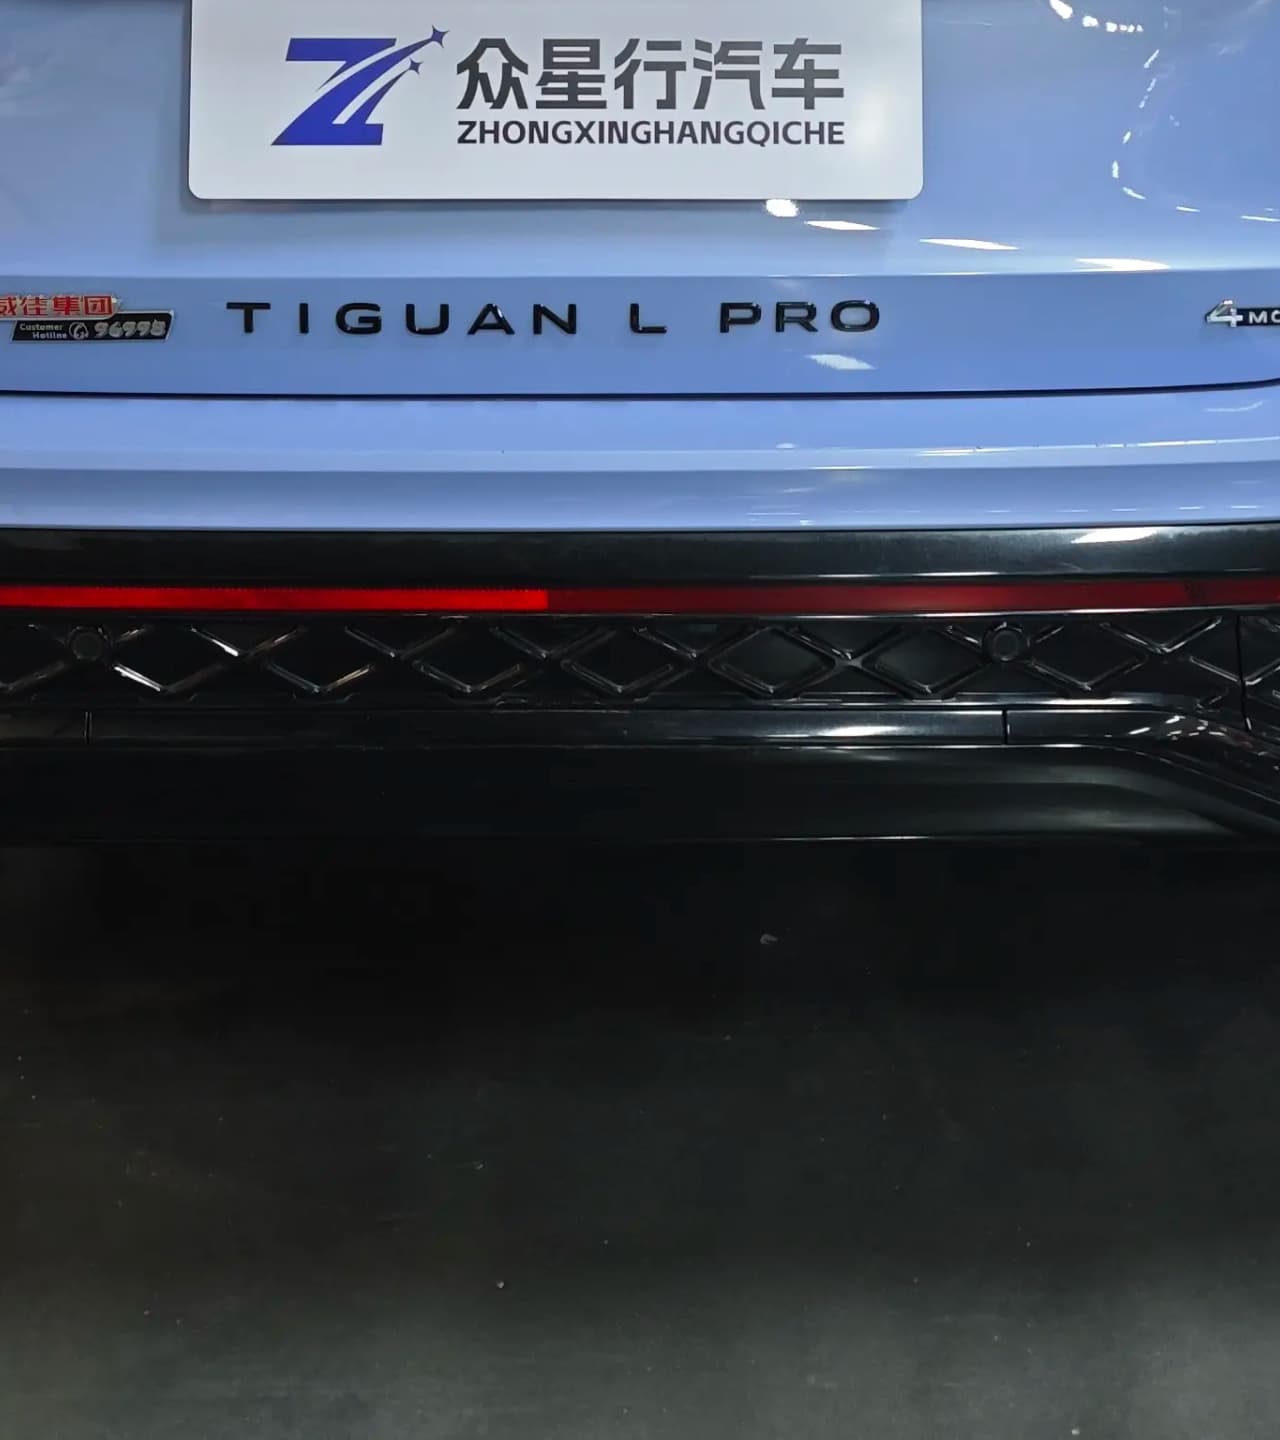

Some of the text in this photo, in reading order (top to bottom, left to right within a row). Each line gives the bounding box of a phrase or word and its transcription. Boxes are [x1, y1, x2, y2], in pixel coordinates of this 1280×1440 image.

[457, 37, 845, 111] 众星行汽车
[457, 120, 845, 147] ZHONGXINGHANGQICHE
[20, 323, 63, 331] Customer
[226, 298, 881, 336] TIGUAN L PRO
